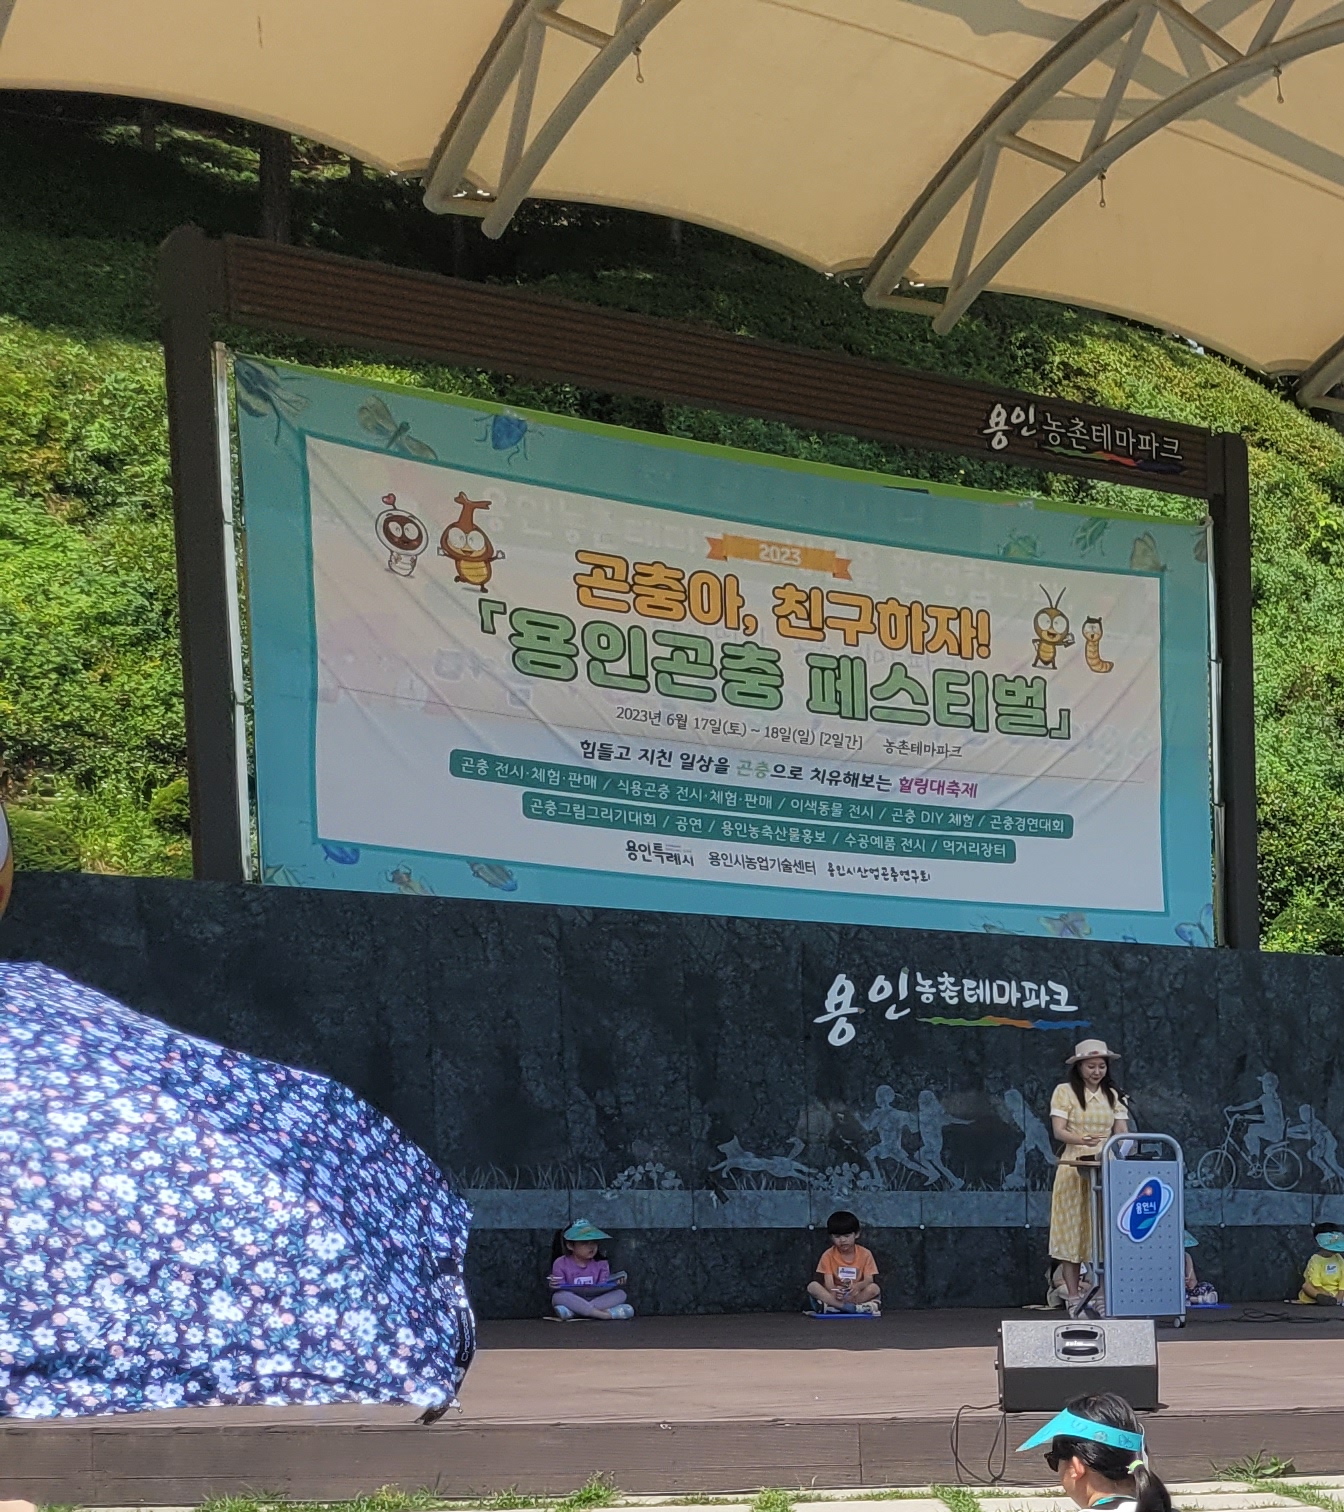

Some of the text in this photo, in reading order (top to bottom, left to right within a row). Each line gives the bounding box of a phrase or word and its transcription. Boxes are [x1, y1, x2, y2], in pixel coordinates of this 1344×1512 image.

[983, 403, 1183, 460] 용인 농촌테마파크
[758, 543, 802, 566] 2023
[573, 549, 758, 636] 곤충아,
[772, 582, 991, 660] 친구하자!
[615, 706, 662, 727] 2023년
[666, 713, 688, 731] 6월
[693, 717, 747, 738] 17일(토)
[763, 726, 816, 746] 18일(일)
[819, 731, 863, 751] [2일간]
[883, 737, 963, 759] 농촌테마파크
[460, 756, 490, 775] 곤충
[617, 778, 671, 800] 식용곤충
[790, 796, 844, 818] 이색동물
[848, 803, 874, 820] 전시
[891, 807, 917, 824] 곤충
[921, 811, 944, 825] DIY
[948, 811, 973, 829] 체험
[989, 814, 1065, 833] 곤충경연대회
[580, 739, 979, 799] 힘들고 지친 일상을 곤충으로 치유해보는 힐링대축제
[529, 797, 657, 827] 곤충그림그리기대회
[674, 816, 702, 833] 공연
[720, 820, 827, 845] 용인농축산물홍보
[844, 832, 897, 852] 수공예품
[900, 838, 926, 854] 전시
[942, 840, 1007, 859] 먹거리장터
[625, 839, 931, 884] 용인특례시 용인시농업기술센터 용인시산업곤충연구회
[813, 965, 1080, 1047] 용인 농촌테마파크
[1135, 1201, 1157, 1215] 용인시
